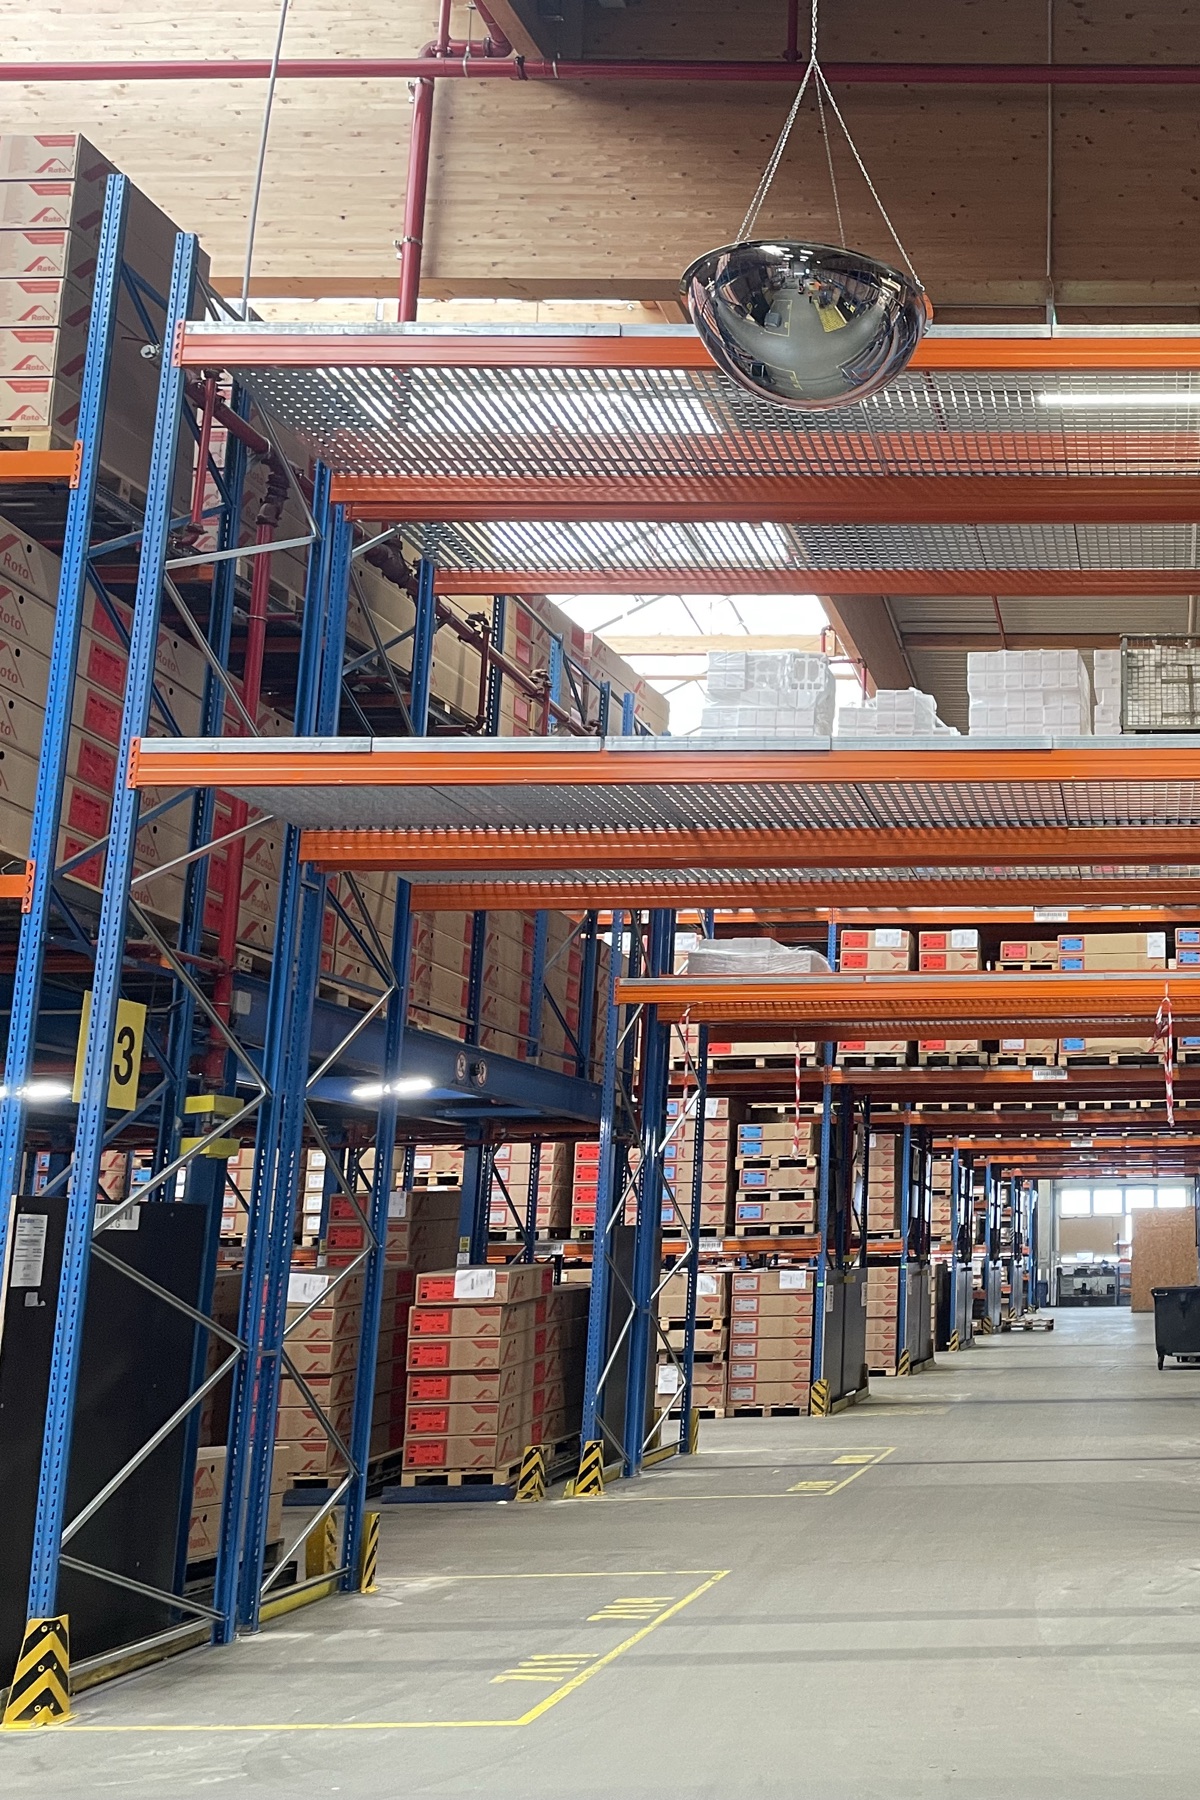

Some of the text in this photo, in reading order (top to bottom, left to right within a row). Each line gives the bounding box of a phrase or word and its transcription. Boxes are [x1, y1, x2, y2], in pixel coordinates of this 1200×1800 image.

[43, 215, 62, 223] Roto
[37, 264, 56, 272] Roto
[26, 363, 45, 371] Roto
[3, 552, 29, 580] Roto
[0, 666, 18, 685] oto
